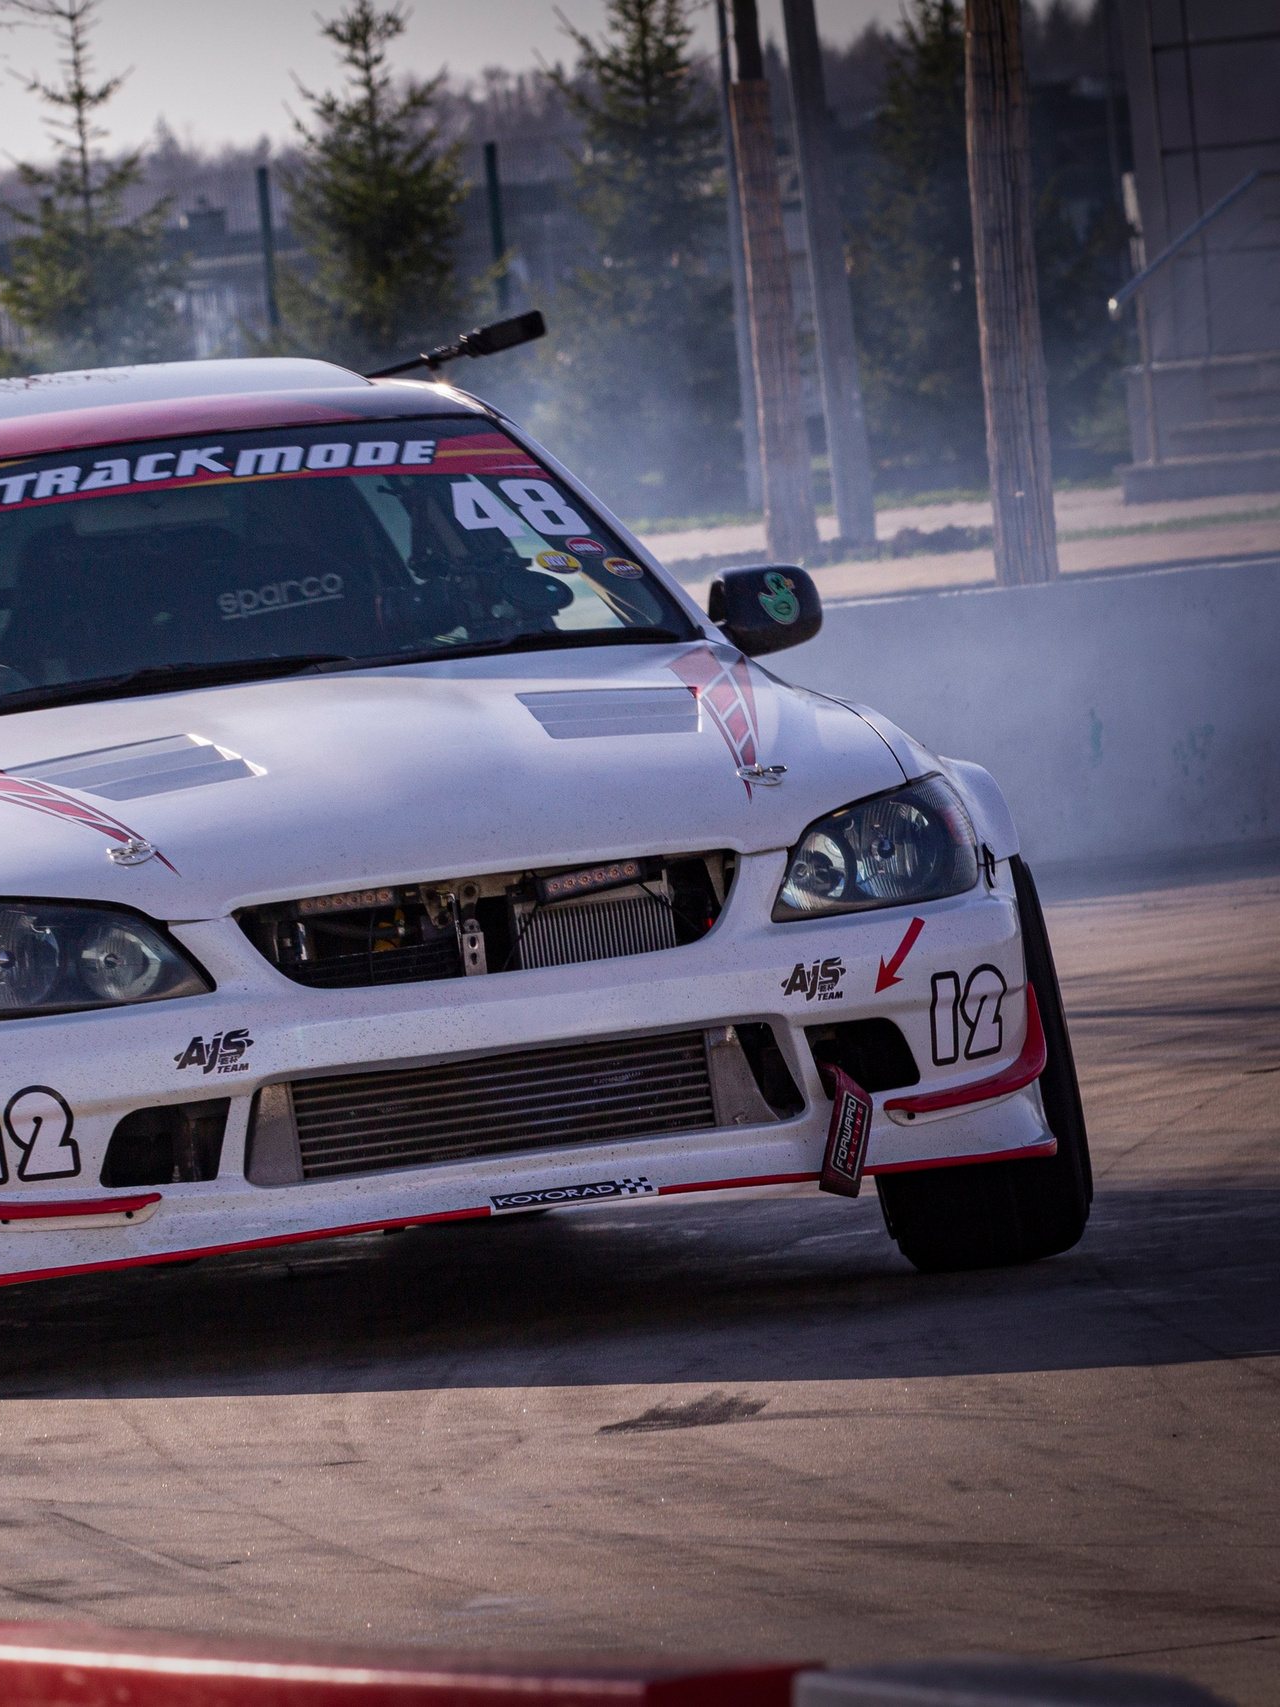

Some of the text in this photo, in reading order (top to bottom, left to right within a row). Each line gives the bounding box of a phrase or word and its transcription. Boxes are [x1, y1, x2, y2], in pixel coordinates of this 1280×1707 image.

[233, 440, 436, 477] MODE
[450, 478, 592, 537] 48
[218, 573, 344, 618] sparco
[818, 991, 843, 1001] TEAM
[930, 963, 1007, 1066] 12
[217, 1063, 249, 1074] TEAM
[836, 1097, 857, 1169] FORWARD
[846, 1106, 864, 1170] RACING
[495, 1185, 616, 1206] KOYORAD
